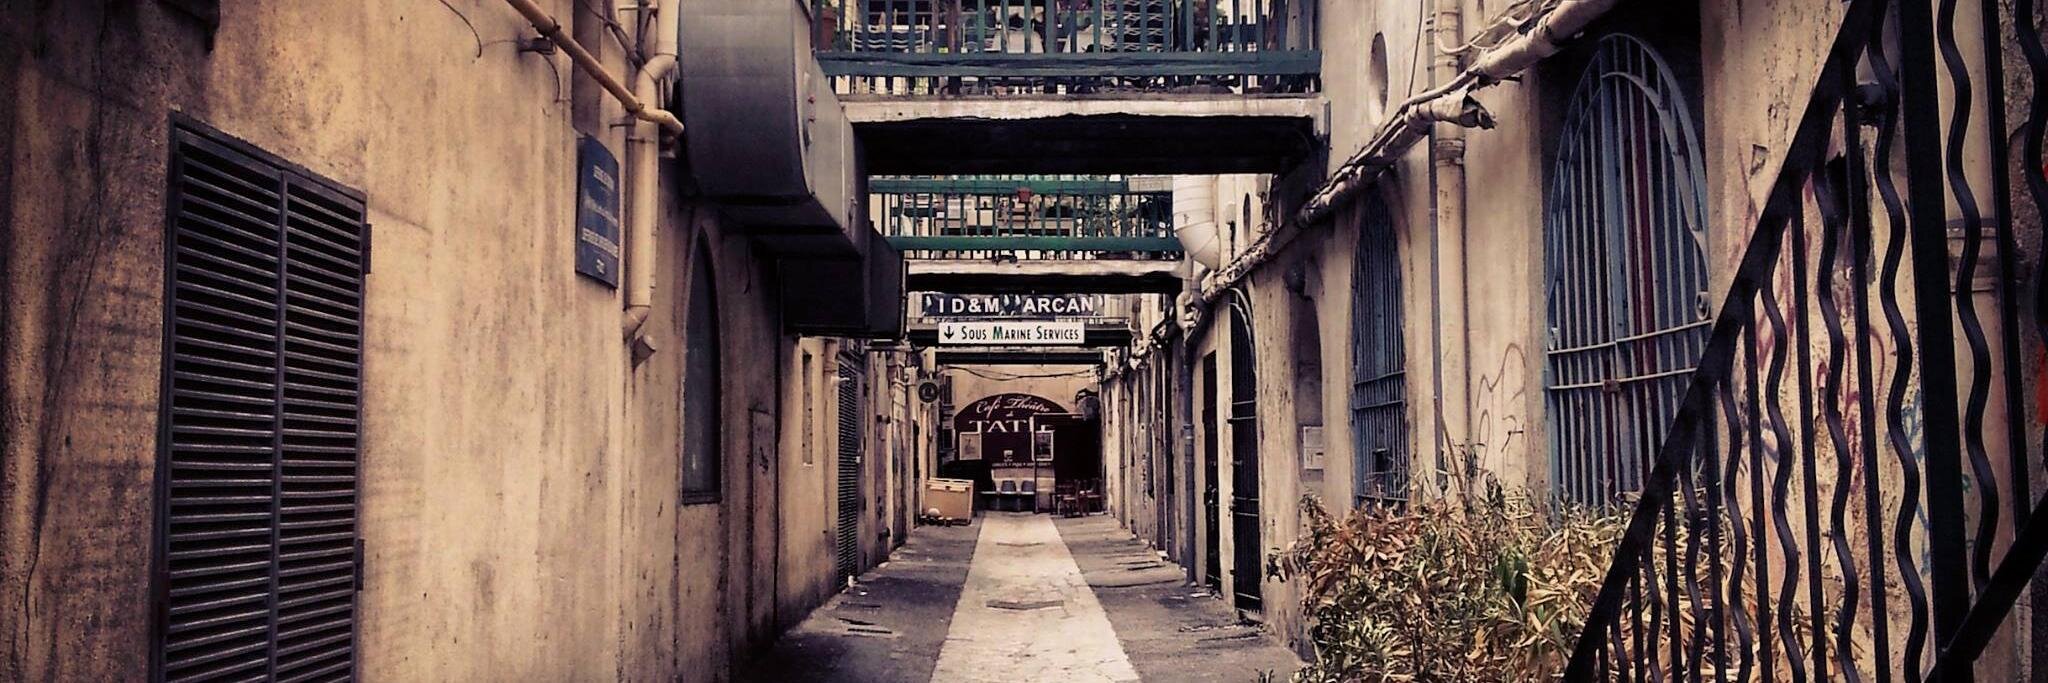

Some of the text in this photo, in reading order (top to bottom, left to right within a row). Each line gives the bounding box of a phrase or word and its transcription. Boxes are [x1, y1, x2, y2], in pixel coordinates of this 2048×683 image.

[1022, 296, 1095, 313] ARCAN
[961, 326, 1080, 340] SOUS MARINE SERVICES
[976, 396, 1002, 419] Café
